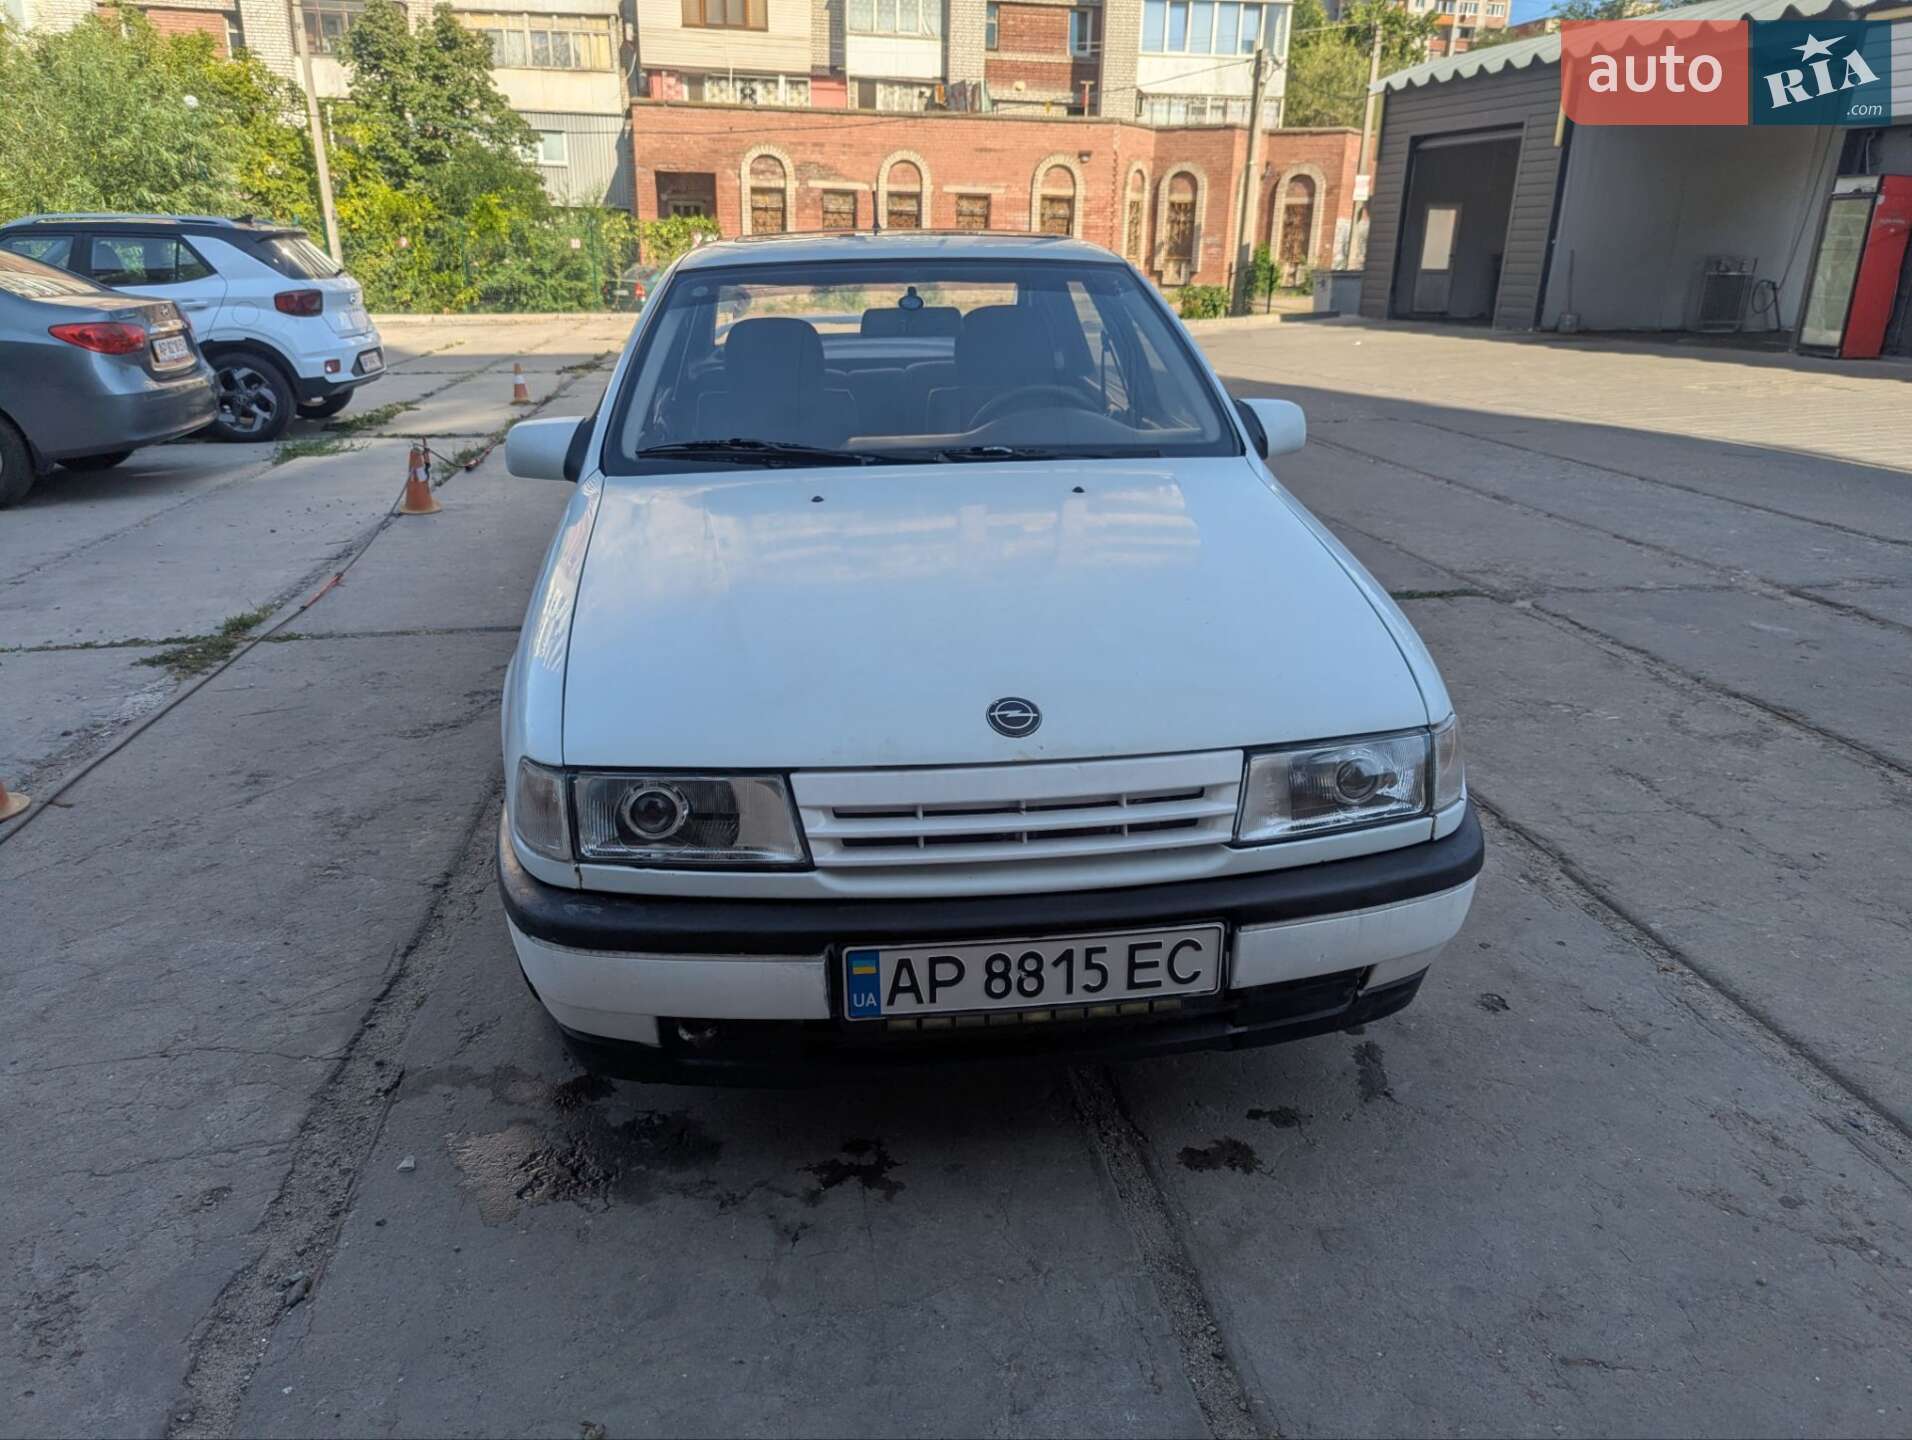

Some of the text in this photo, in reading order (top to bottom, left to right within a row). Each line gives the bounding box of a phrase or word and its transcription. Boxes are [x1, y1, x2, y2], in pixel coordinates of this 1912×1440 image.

[853, 937, 1204, 1009] UA AP 8815 EC
